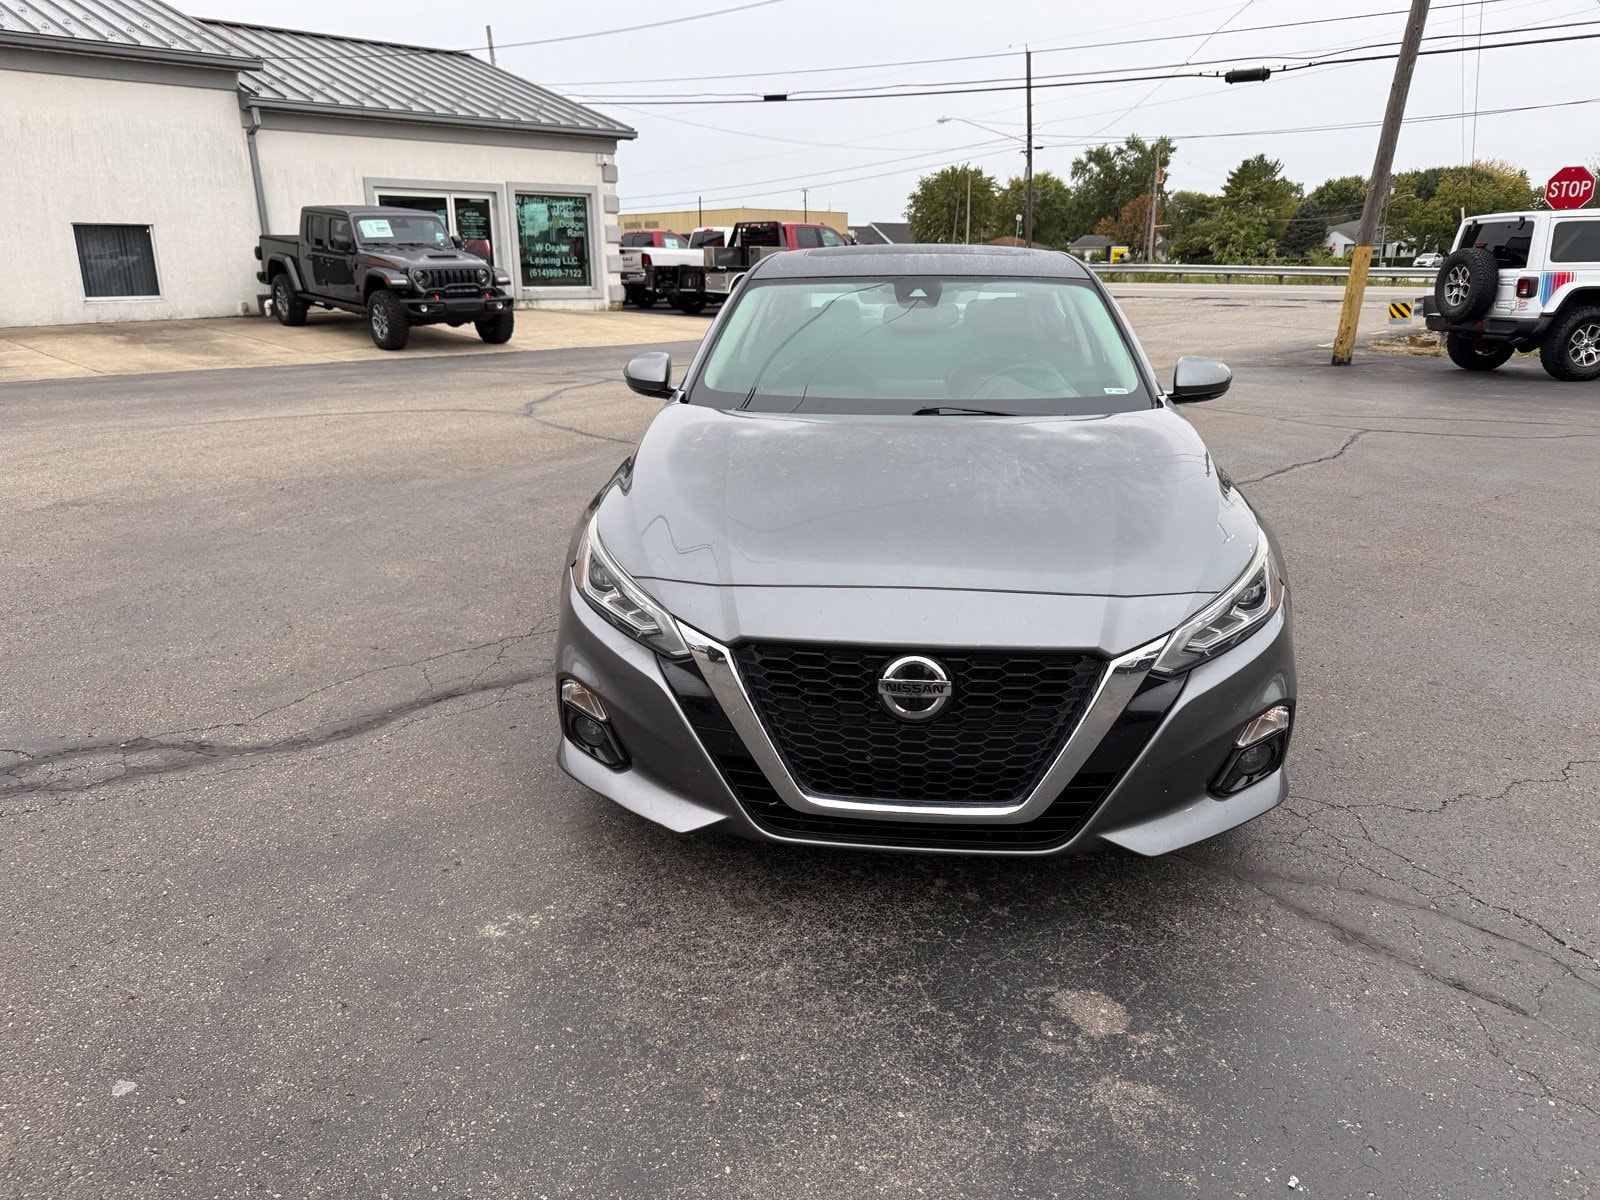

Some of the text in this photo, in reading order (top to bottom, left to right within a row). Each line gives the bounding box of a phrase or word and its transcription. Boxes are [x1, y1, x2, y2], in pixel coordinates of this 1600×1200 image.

[1548, 180, 1592, 198] STOP
[524, 197, 542, 205] Auto
[560, 221, 584, 230] Dodge
[567, 229, 585, 238] Ram
[535, 243, 570, 252] W Dealer
[530, 256, 581, 266] Leasing LLC.
[885, 683, 944, 694] NISSAN
